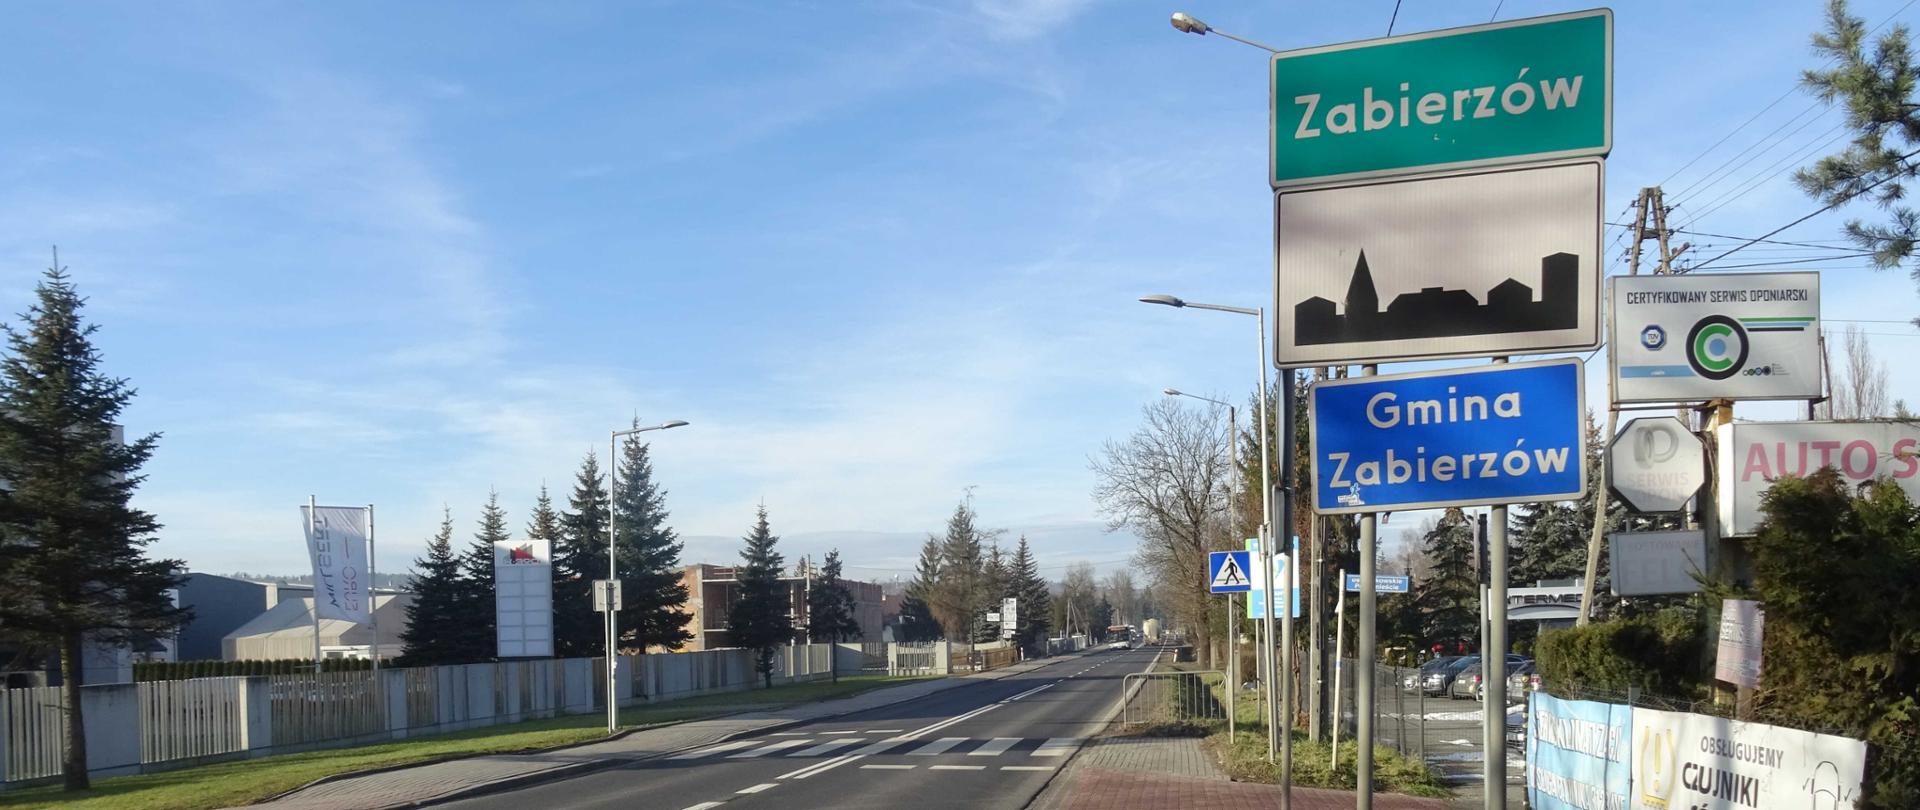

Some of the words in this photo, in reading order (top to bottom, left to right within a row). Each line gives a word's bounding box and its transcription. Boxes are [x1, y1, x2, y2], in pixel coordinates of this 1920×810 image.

[1294, 67, 1583, 139] Zabierzów
[1627, 290, 1707, 305] CERTYFIKOWANY
[1710, 289, 1748, 303] SERWIS
[1750, 288, 1808, 302] OPONIARSKI
[1366, 386, 1521, 429] Gmina
[1328, 439, 1569, 489] Zabierzów
[1626, 471, 1689, 487] SERWIS
[1740, 439, 1877, 482] AUTO
[1506, 593, 1583, 605] TERME
[1700, 735, 1784, 769] OBSŁUGUJEMY
[1682, 761, 1759, 808] CZUJNIKI
